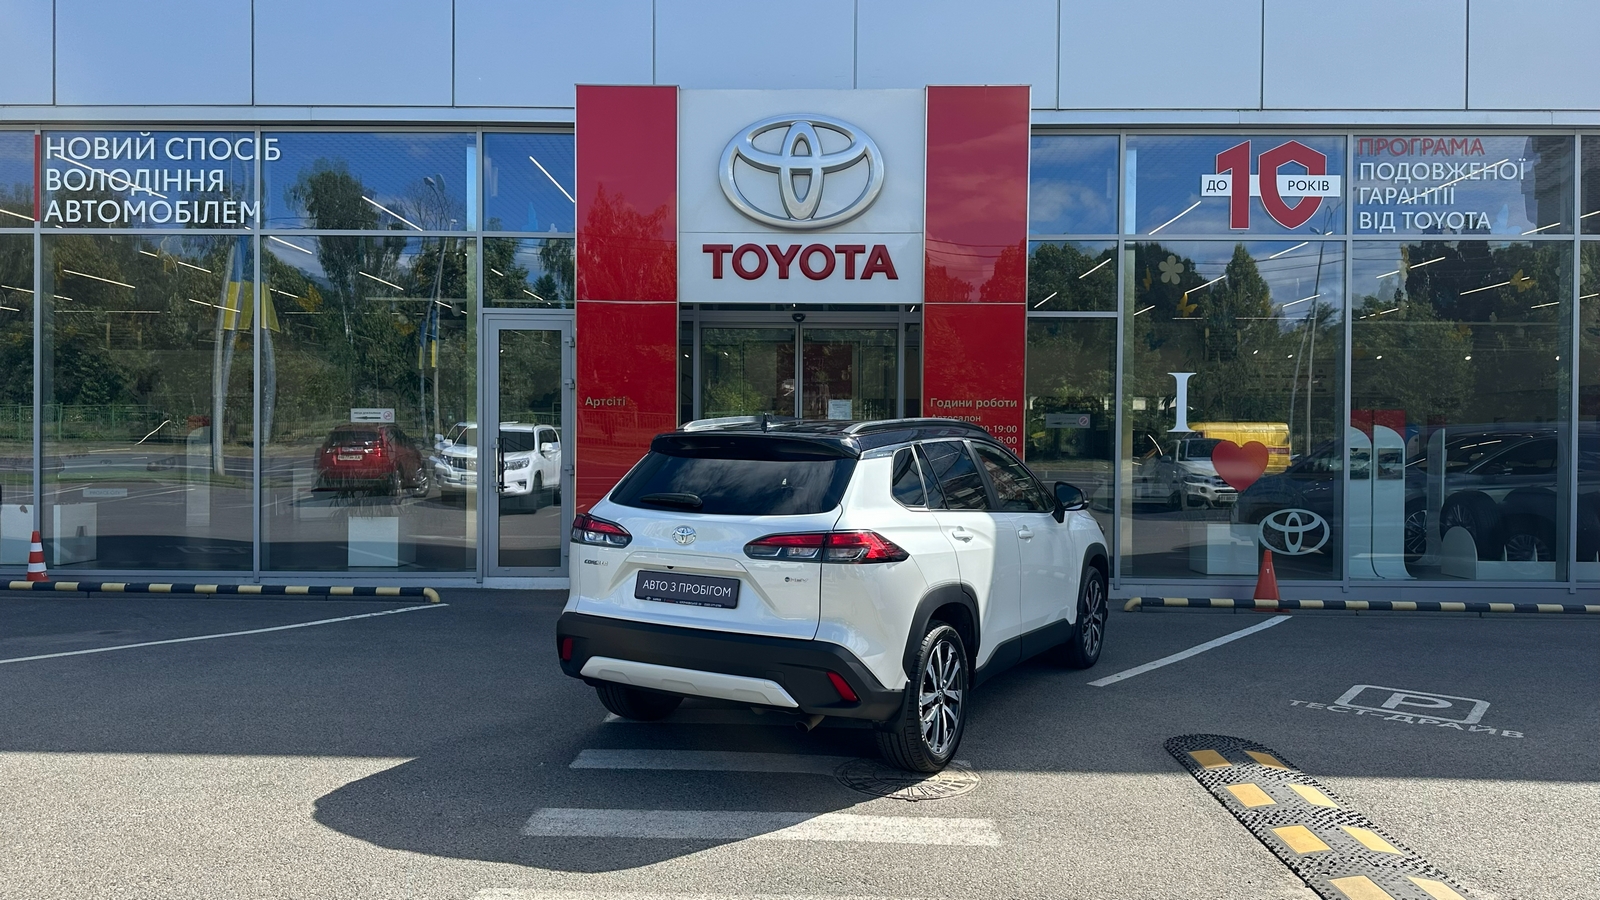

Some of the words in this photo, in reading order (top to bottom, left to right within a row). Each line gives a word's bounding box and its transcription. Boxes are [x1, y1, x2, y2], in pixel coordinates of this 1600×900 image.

[46, 132, 155, 160] НОВИЙ
[165, 137, 281, 161] СПОСІБ
[1358, 138, 1486, 156] ПРОГРАМА
[46, 168, 224, 196] ВОЛОДІННЯ
[1360, 158, 1527, 184] ПОДОВЖЕНОЇ
[1206, 180, 1228, 193] ДО
[1216, 139, 1328, 230] 10
[1287, 180, 1330, 191] РОКІВ
[1360, 182, 1457, 205] ГАРАНТІЇ
[44, 200, 261, 224] АВТОМОБІЛЕМ
[1360, 211, 1396, 234] ВІД
[1402, 211, 1492, 230] TOYOTA
[702, 243, 899, 281] TOYOTA
[585, 396, 626, 409] Артсіті
[930, 397, 973, 409] Години
[976, 397, 1018, 410] роботи
[1166, 372, 1198, 433] I
[643, 580, 668, 592] АВТО
[678, 583, 732, 598] ПРОБІГОМ
[1289, 699, 1524, 738] ТЕСТ-ДРАЙВ
